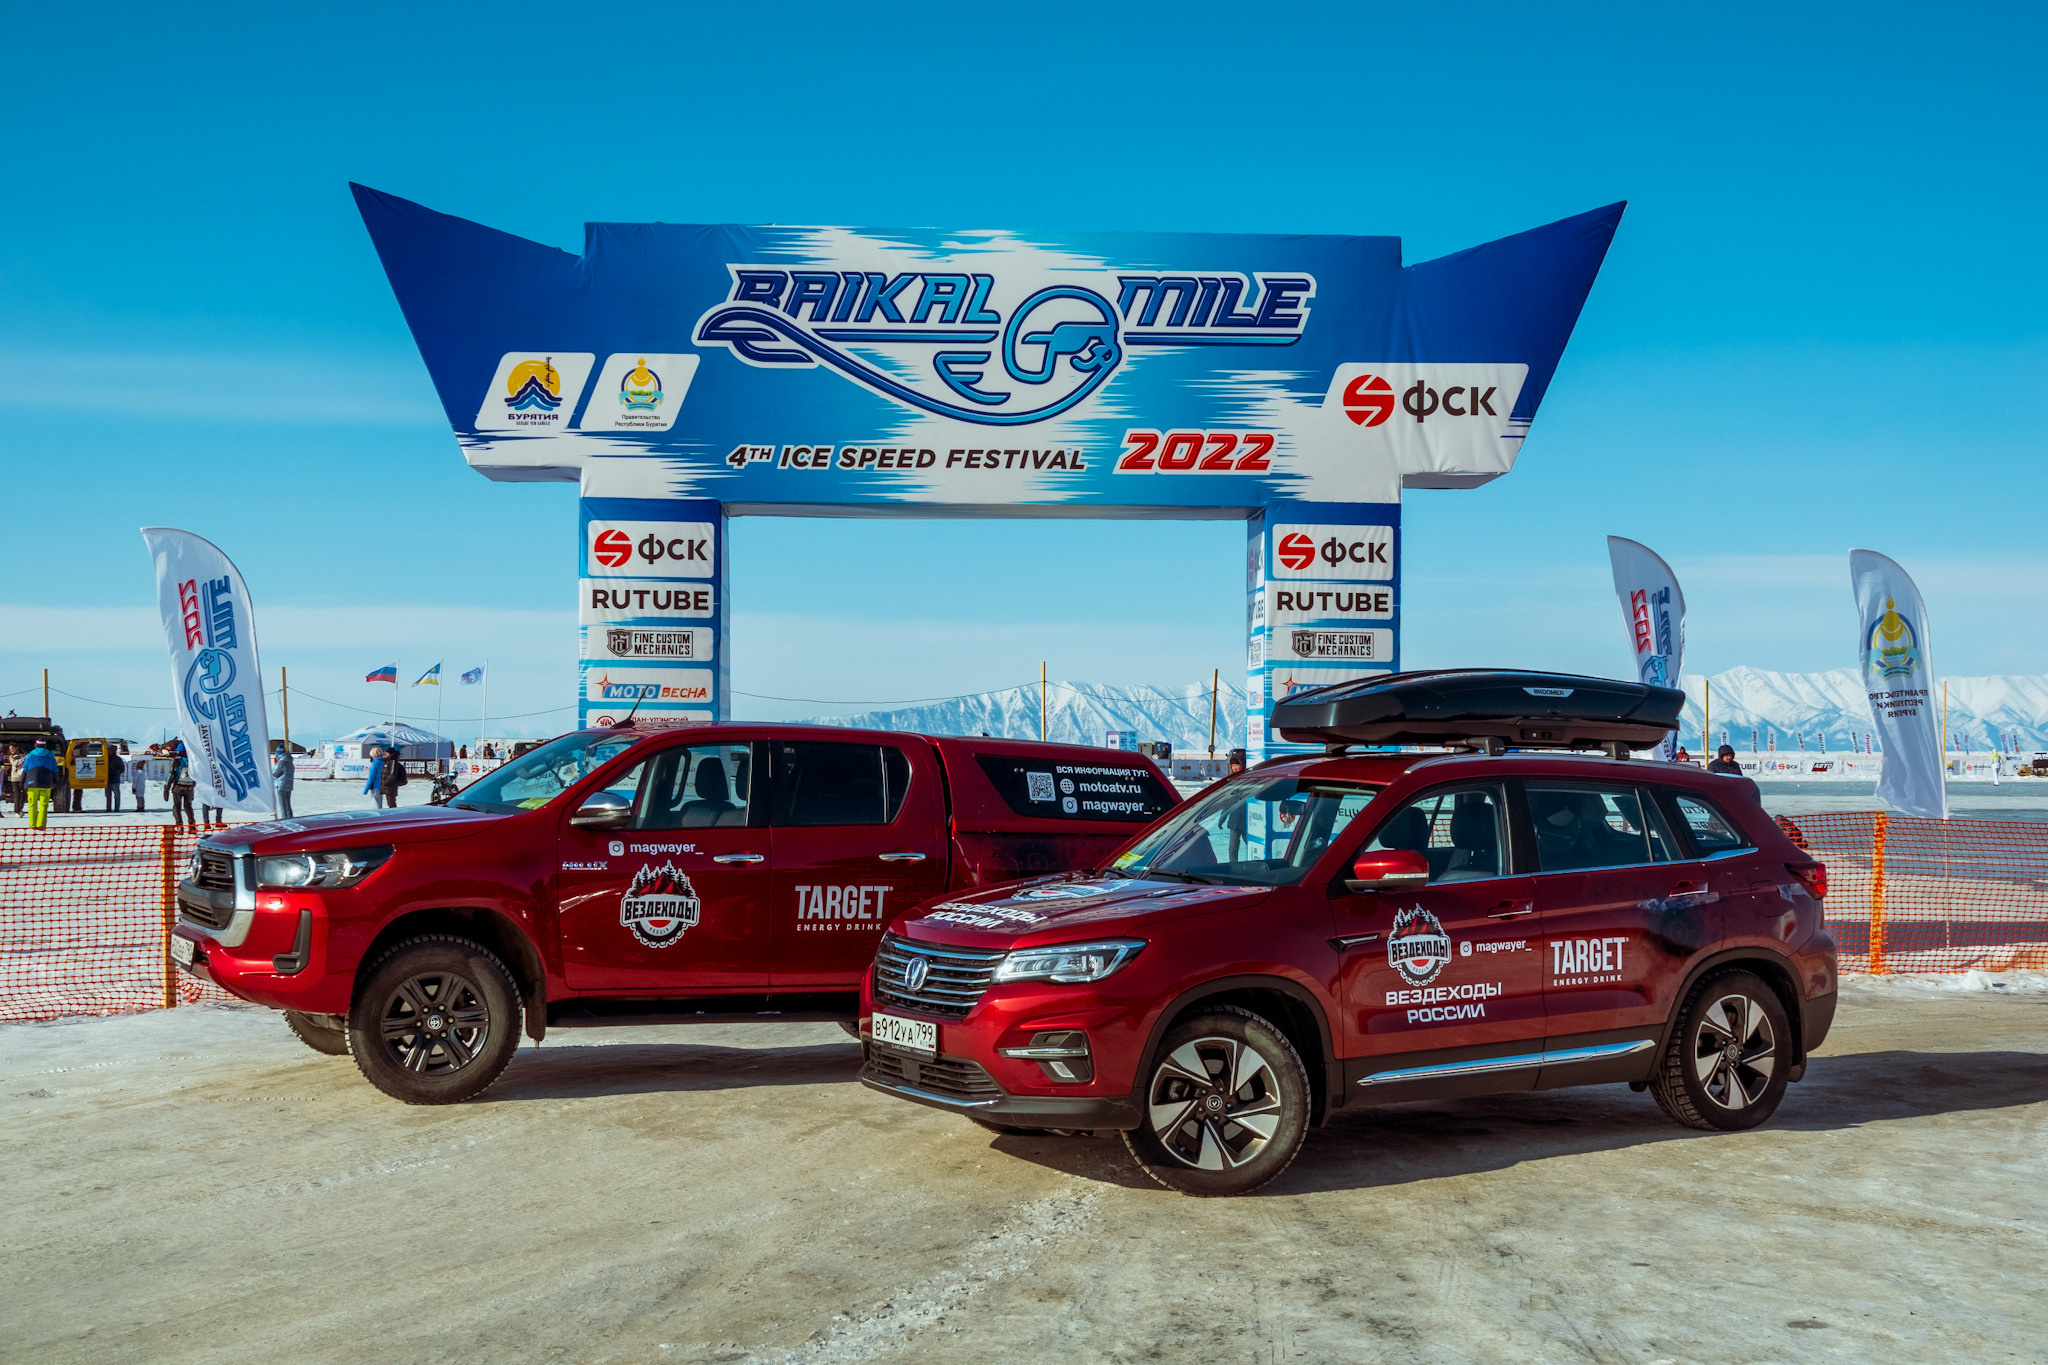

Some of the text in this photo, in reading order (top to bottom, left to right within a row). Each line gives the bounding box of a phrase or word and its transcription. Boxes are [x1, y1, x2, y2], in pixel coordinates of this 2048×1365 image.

[732, 269, 1312, 328] BAIKAL MILE
[1402, 380, 1498, 423] ФСК
[507, 413, 559, 421] БУРЯТИЯ
[780, 446, 832, 468] ICE
[838, 447, 937, 469] SPEED
[945, 449, 1087, 470] FESTIVAL
[1118, 432, 1275, 471] 2022
[637, 533, 708, 565] ФСК
[1320, 536, 1388, 568] ФСК
[592, 589, 710, 611] RUTUBE
[1276, 591, 1389, 613] RUTUBE
[634, 633, 690, 644] FINE CUSTOM
[1317, 634, 1372, 646] FINE CUSTOM
[634, 645, 690, 655] MECHANICS
[1317, 646, 1372, 656] MECHANICS
[1056, 766, 1073, 774] ВСЯ
[1074, 767, 1131, 777] ИНФОРМАЦИЯ
[1079, 782, 1142, 793] motoatv.ru
[1082, 800, 1153, 814] magwayer_
[630, 843, 704, 855] magwayer_
[625, 901, 697, 922] ВЕЗДЕХОДЫ
[846, 923, 882, 931] DRINK
[1390, 939, 1449, 962] ВЕЗДЕХОДЫ
[1553, 974, 1622, 987] ENERGY DRINK
[1385, 982, 1503, 1006] ВЕЗДЕХОДЫ
[1406, 1003, 1486, 1024] РОССИИ
